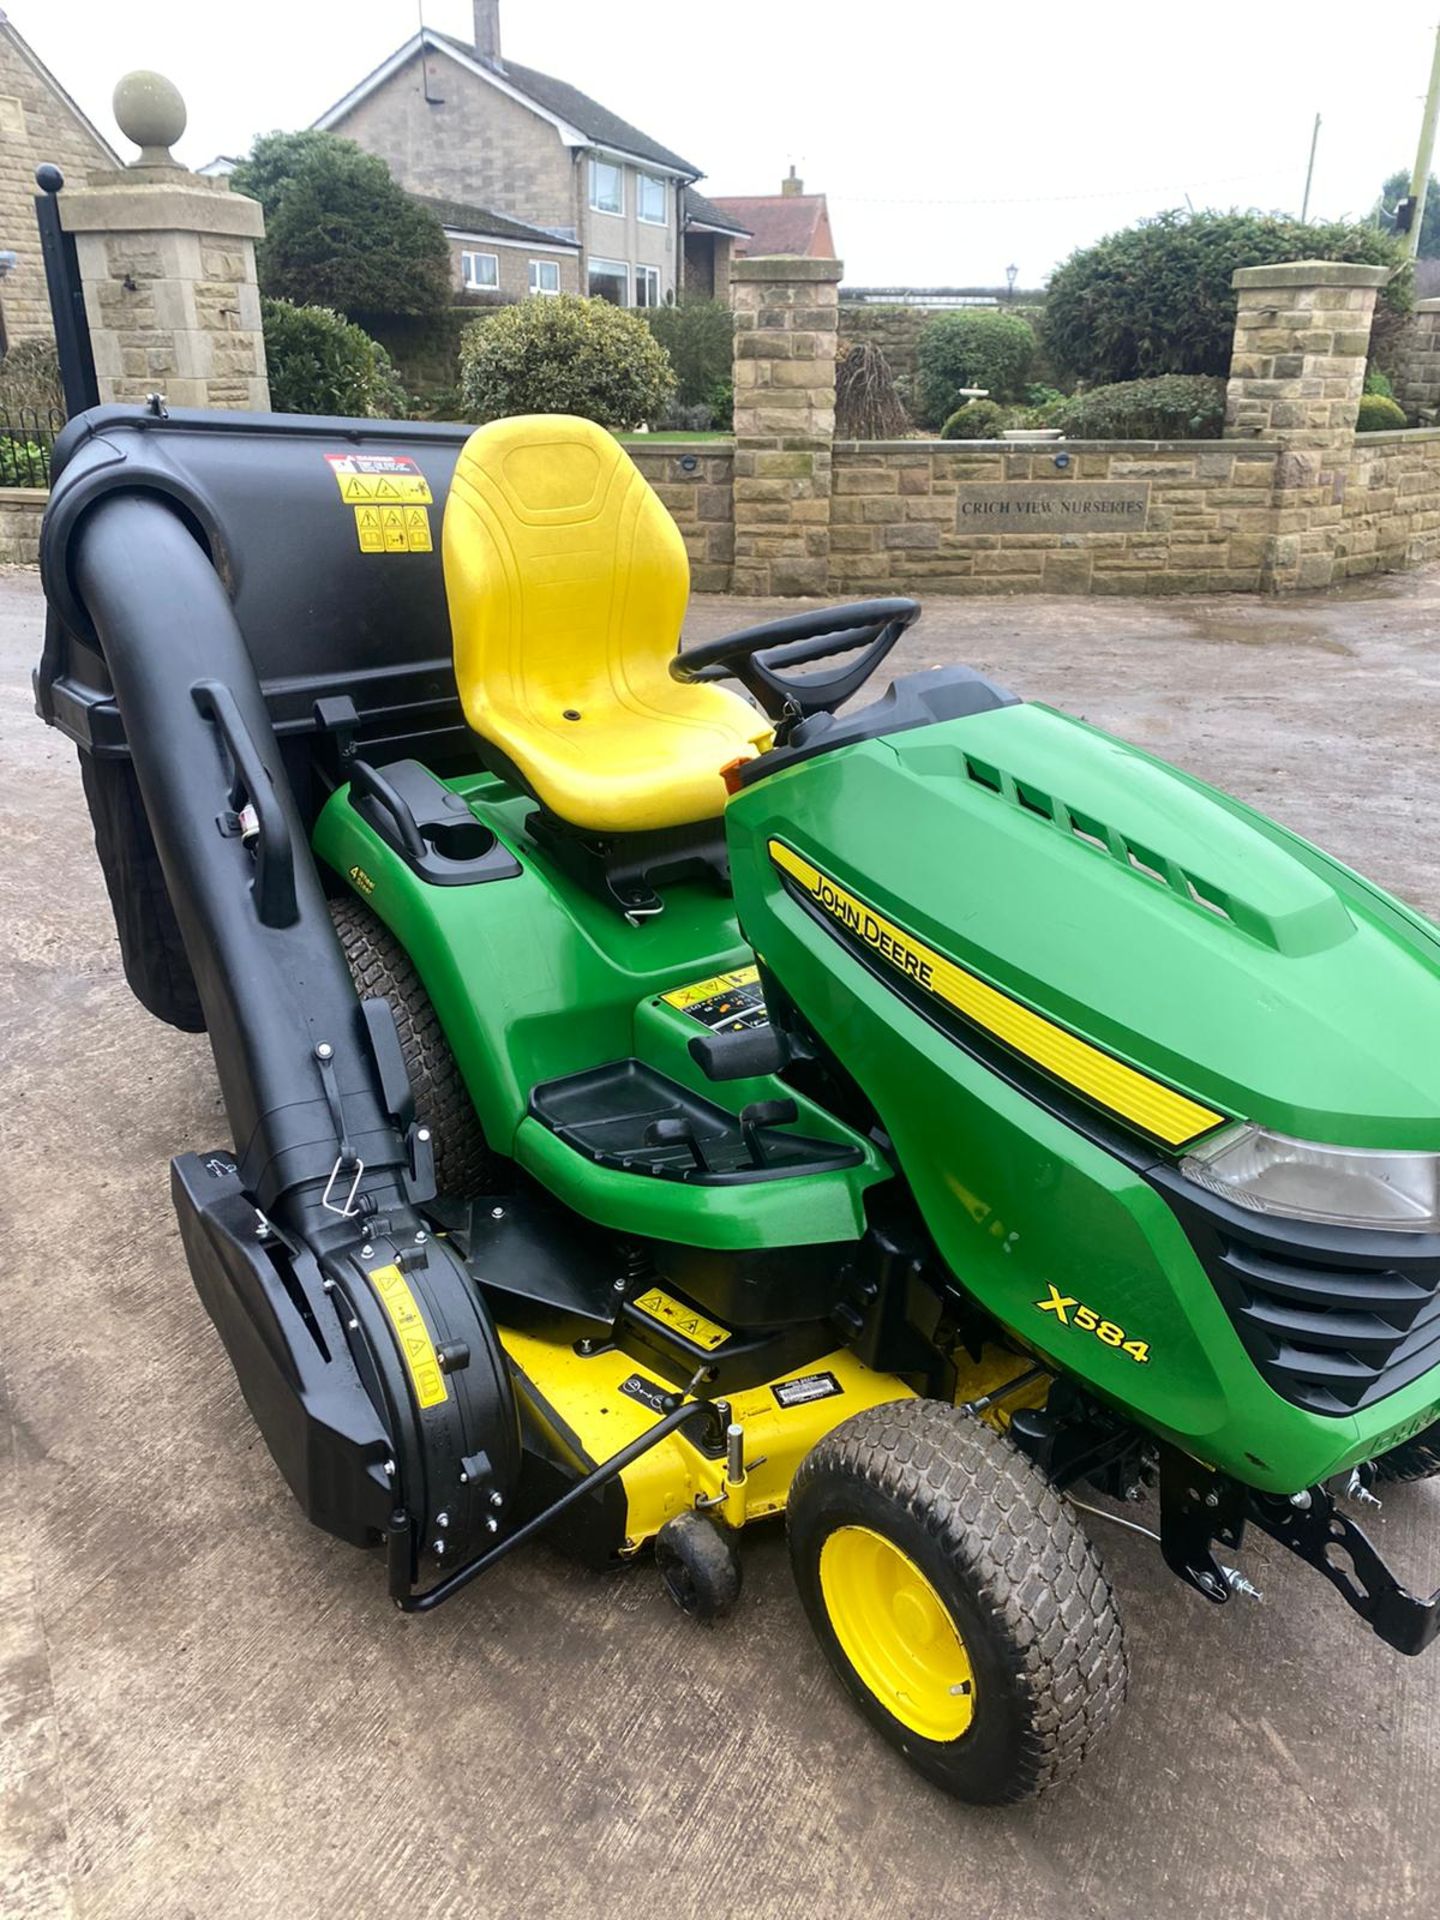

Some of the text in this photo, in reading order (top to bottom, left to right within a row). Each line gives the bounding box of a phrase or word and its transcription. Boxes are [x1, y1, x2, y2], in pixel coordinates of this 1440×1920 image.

[962, 500, 1144, 516] CRICH VIEW NURSERIES
[811, 875, 934, 990] JOHN DEERE
[1034, 1281, 1151, 1363] X584
